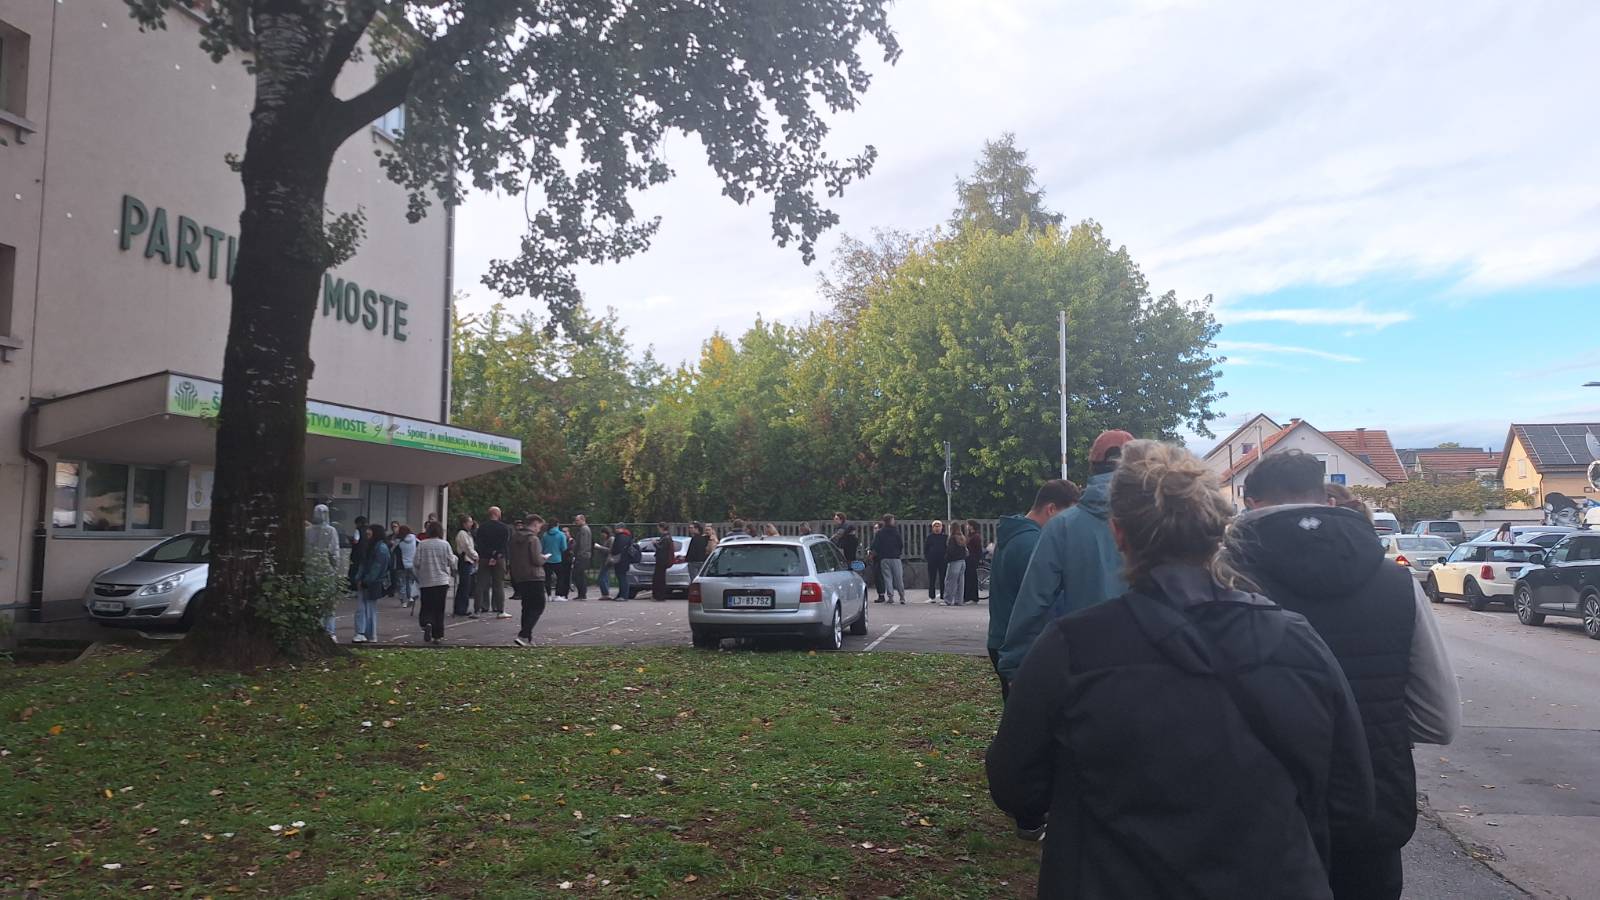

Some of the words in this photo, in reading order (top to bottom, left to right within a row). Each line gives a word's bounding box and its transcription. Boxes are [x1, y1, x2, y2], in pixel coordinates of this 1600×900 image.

[119, 194, 240, 286] PARTI
[322, 272, 408, 342] MOSTE
[334, 416, 367, 434] MOSTE
